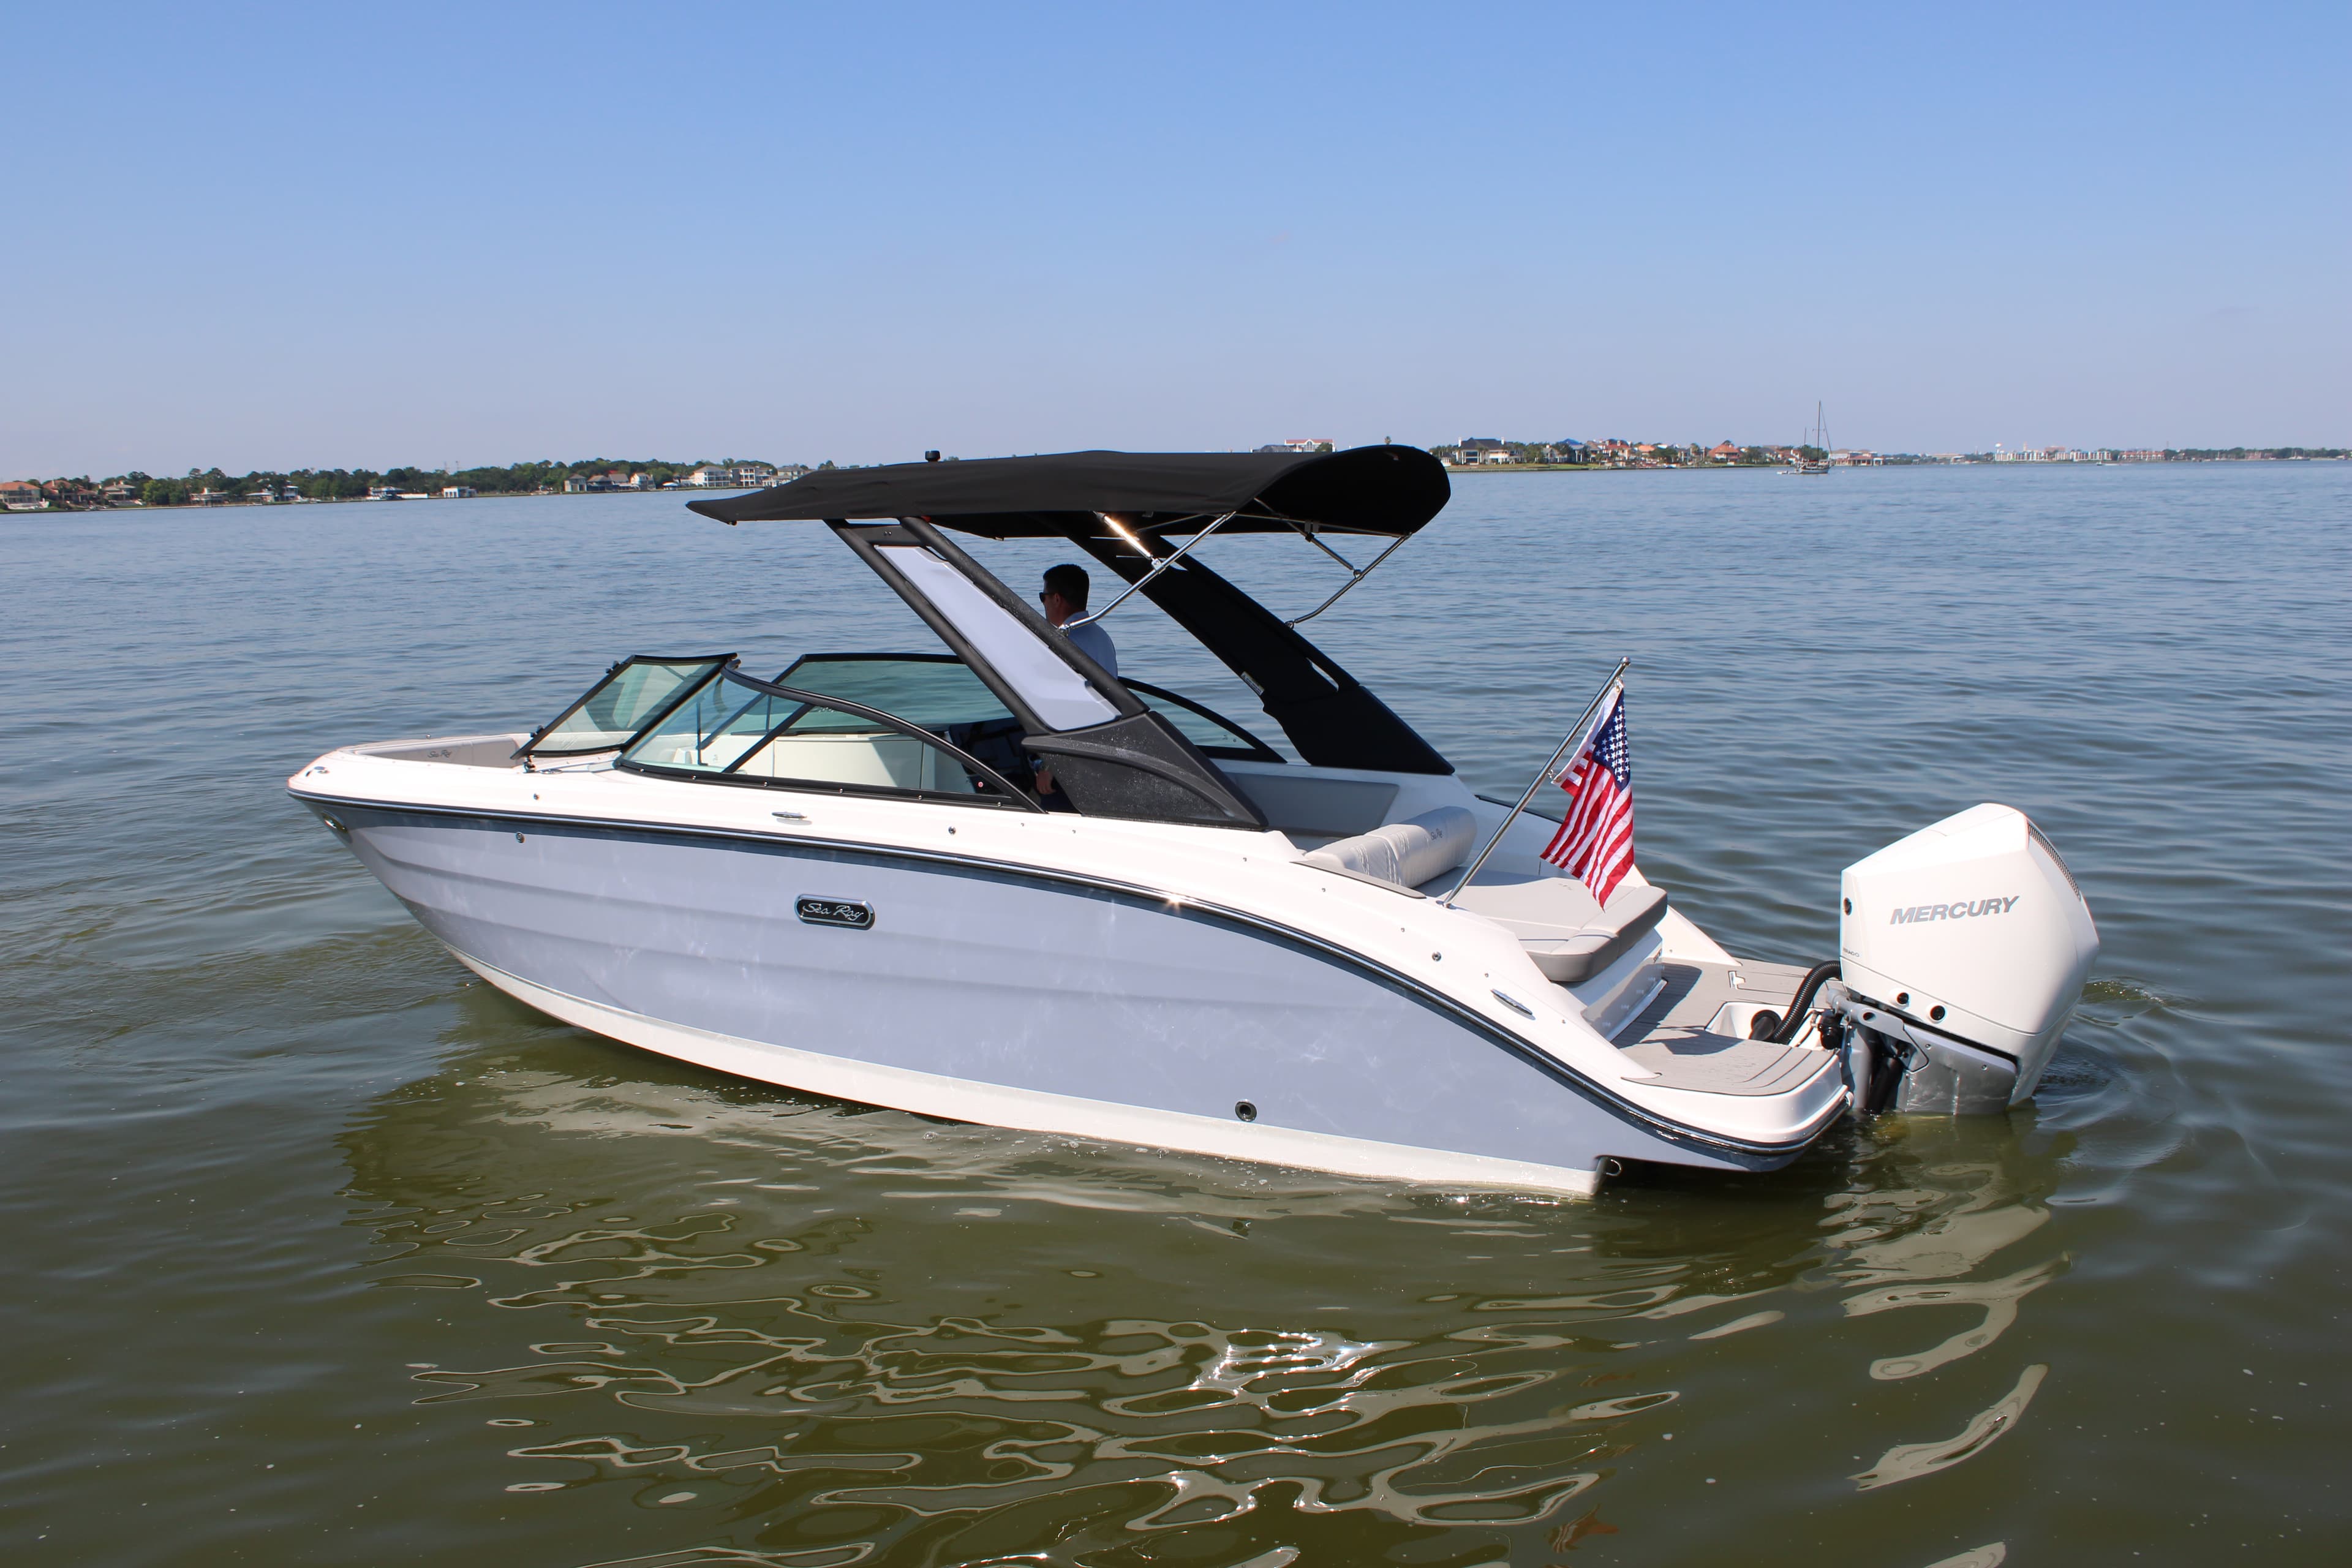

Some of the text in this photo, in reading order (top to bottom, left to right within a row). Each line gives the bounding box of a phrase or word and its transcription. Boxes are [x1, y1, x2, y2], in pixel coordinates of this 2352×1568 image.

[802, 903, 864, 921] Sea Ray
[1890, 895, 2020, 925] MERCURY
